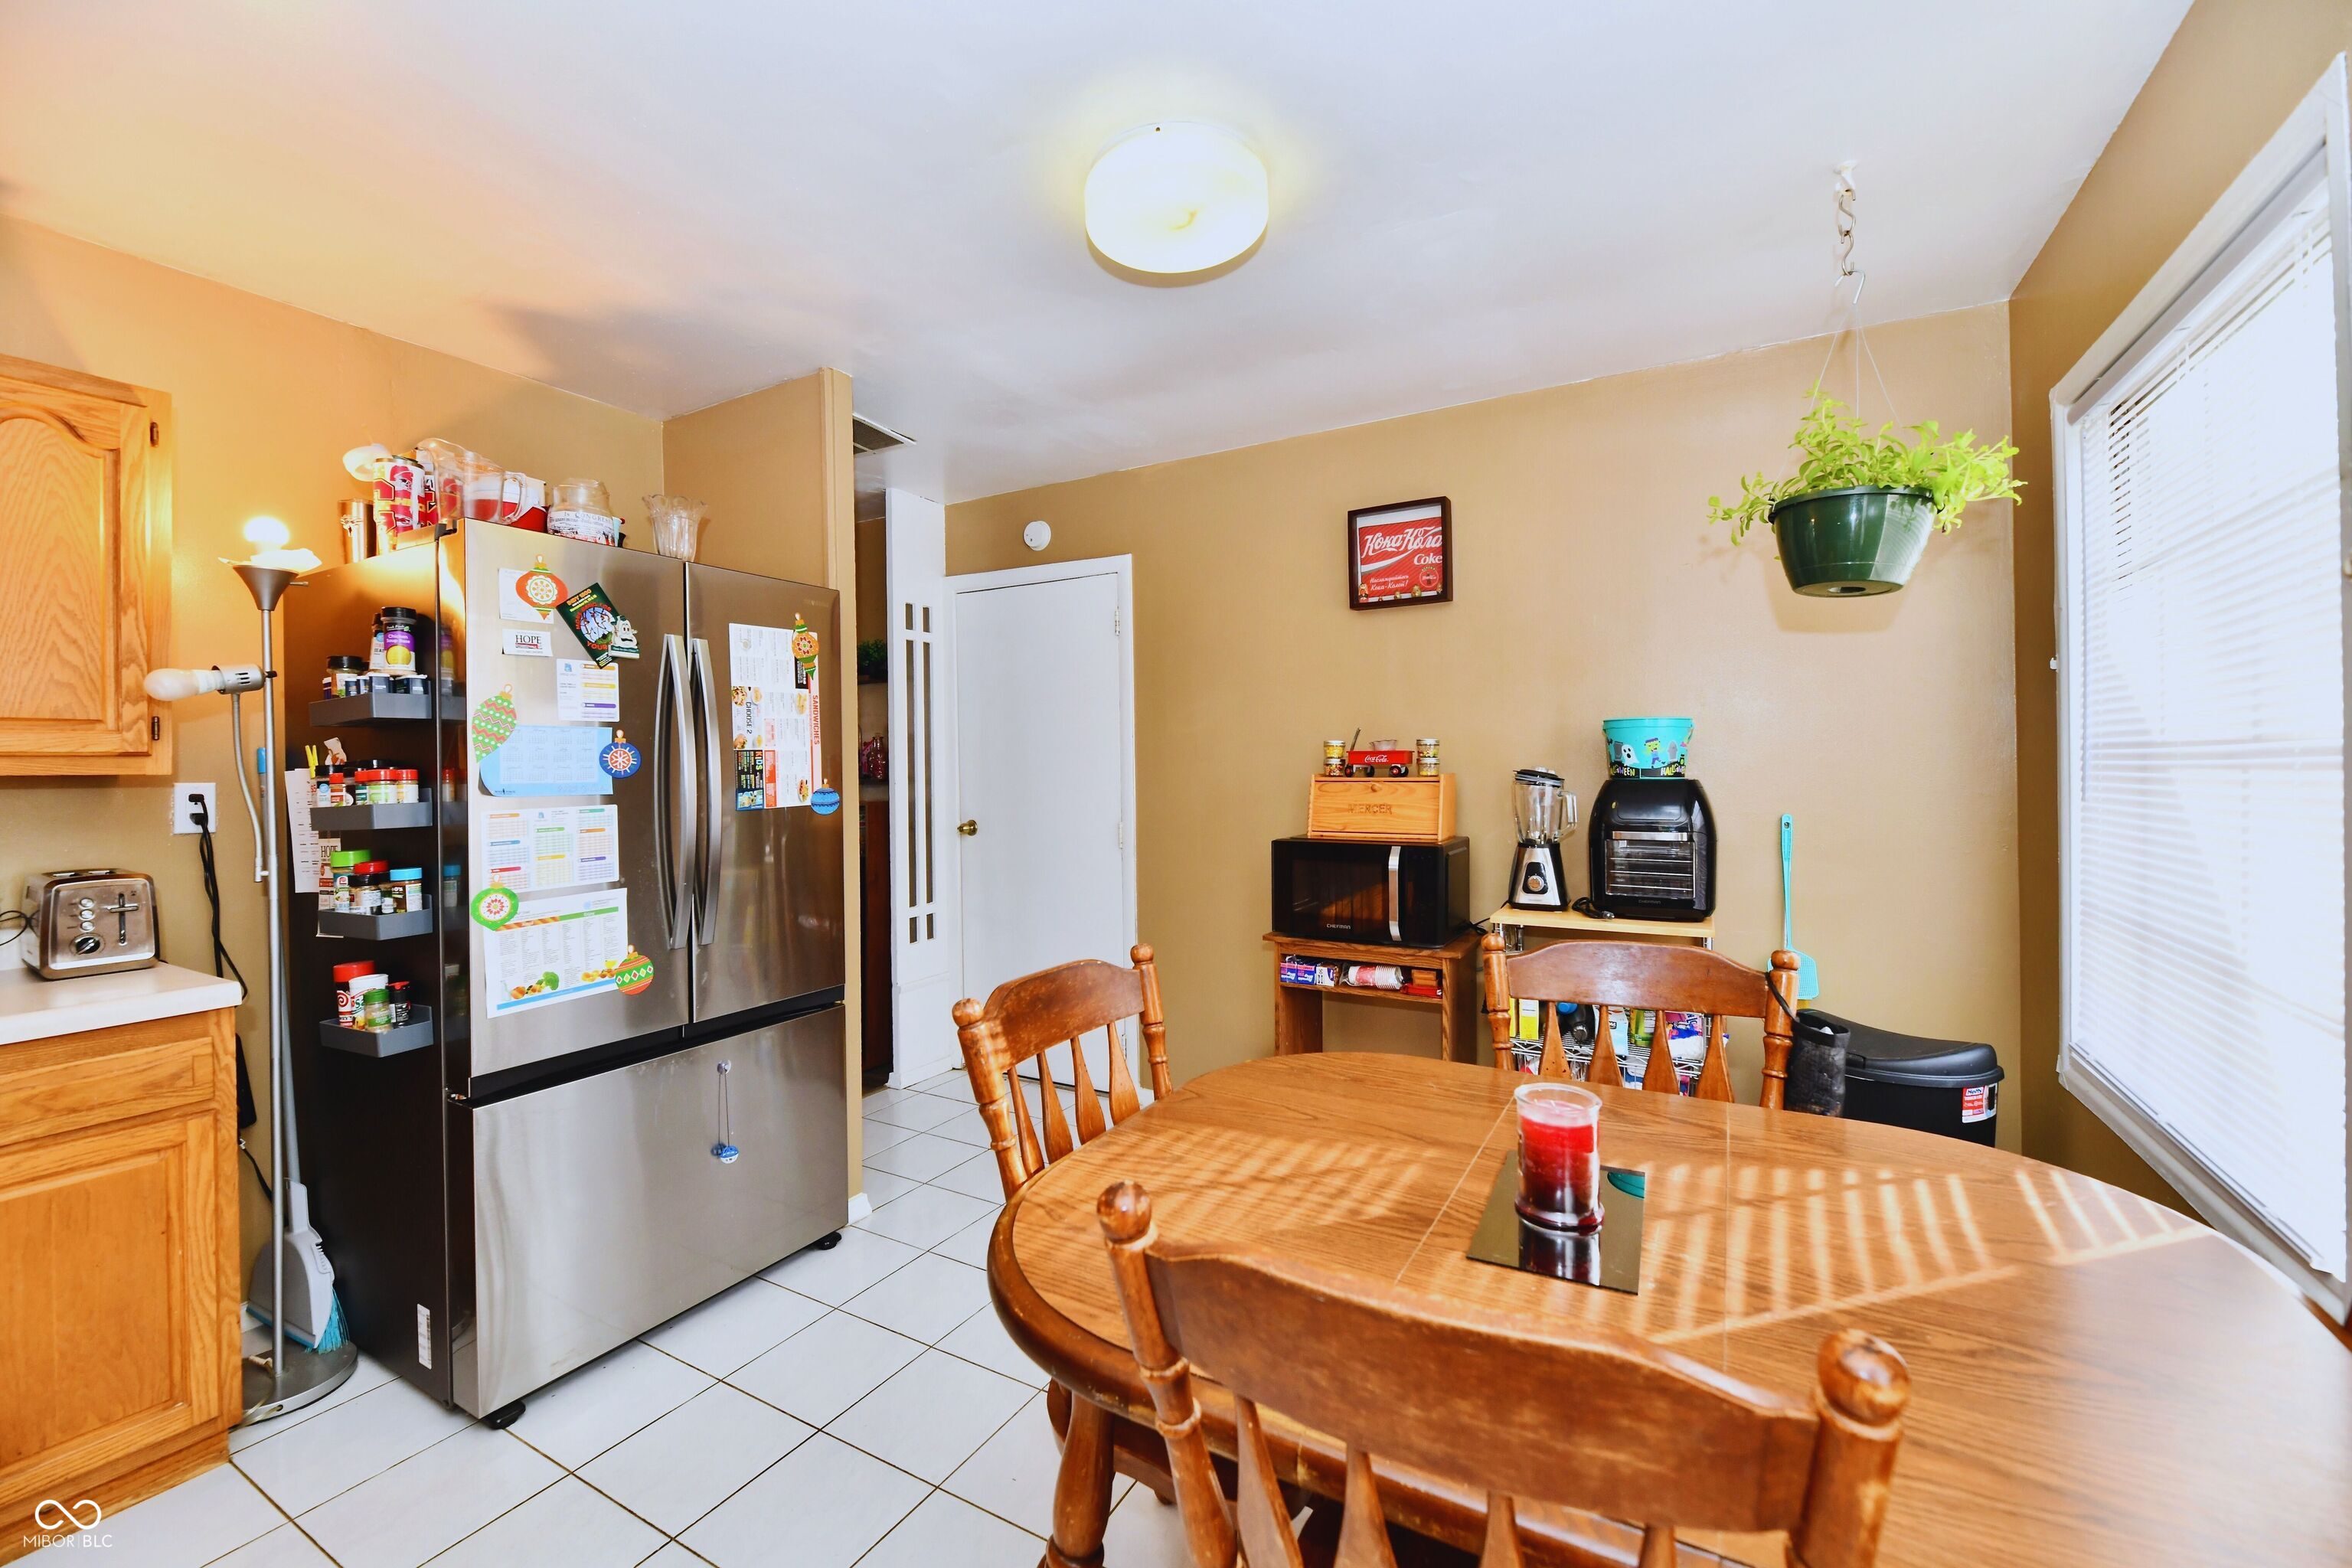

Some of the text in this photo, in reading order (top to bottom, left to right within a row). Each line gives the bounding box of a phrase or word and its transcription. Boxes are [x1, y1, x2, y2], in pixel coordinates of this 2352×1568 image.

[1413, 554, 1442, 565] Coke
[515, 635, 541, 644] HOPE
[755, 751, 763, 770] KIDS
[1348, 802, 1393, 815] MERCER
